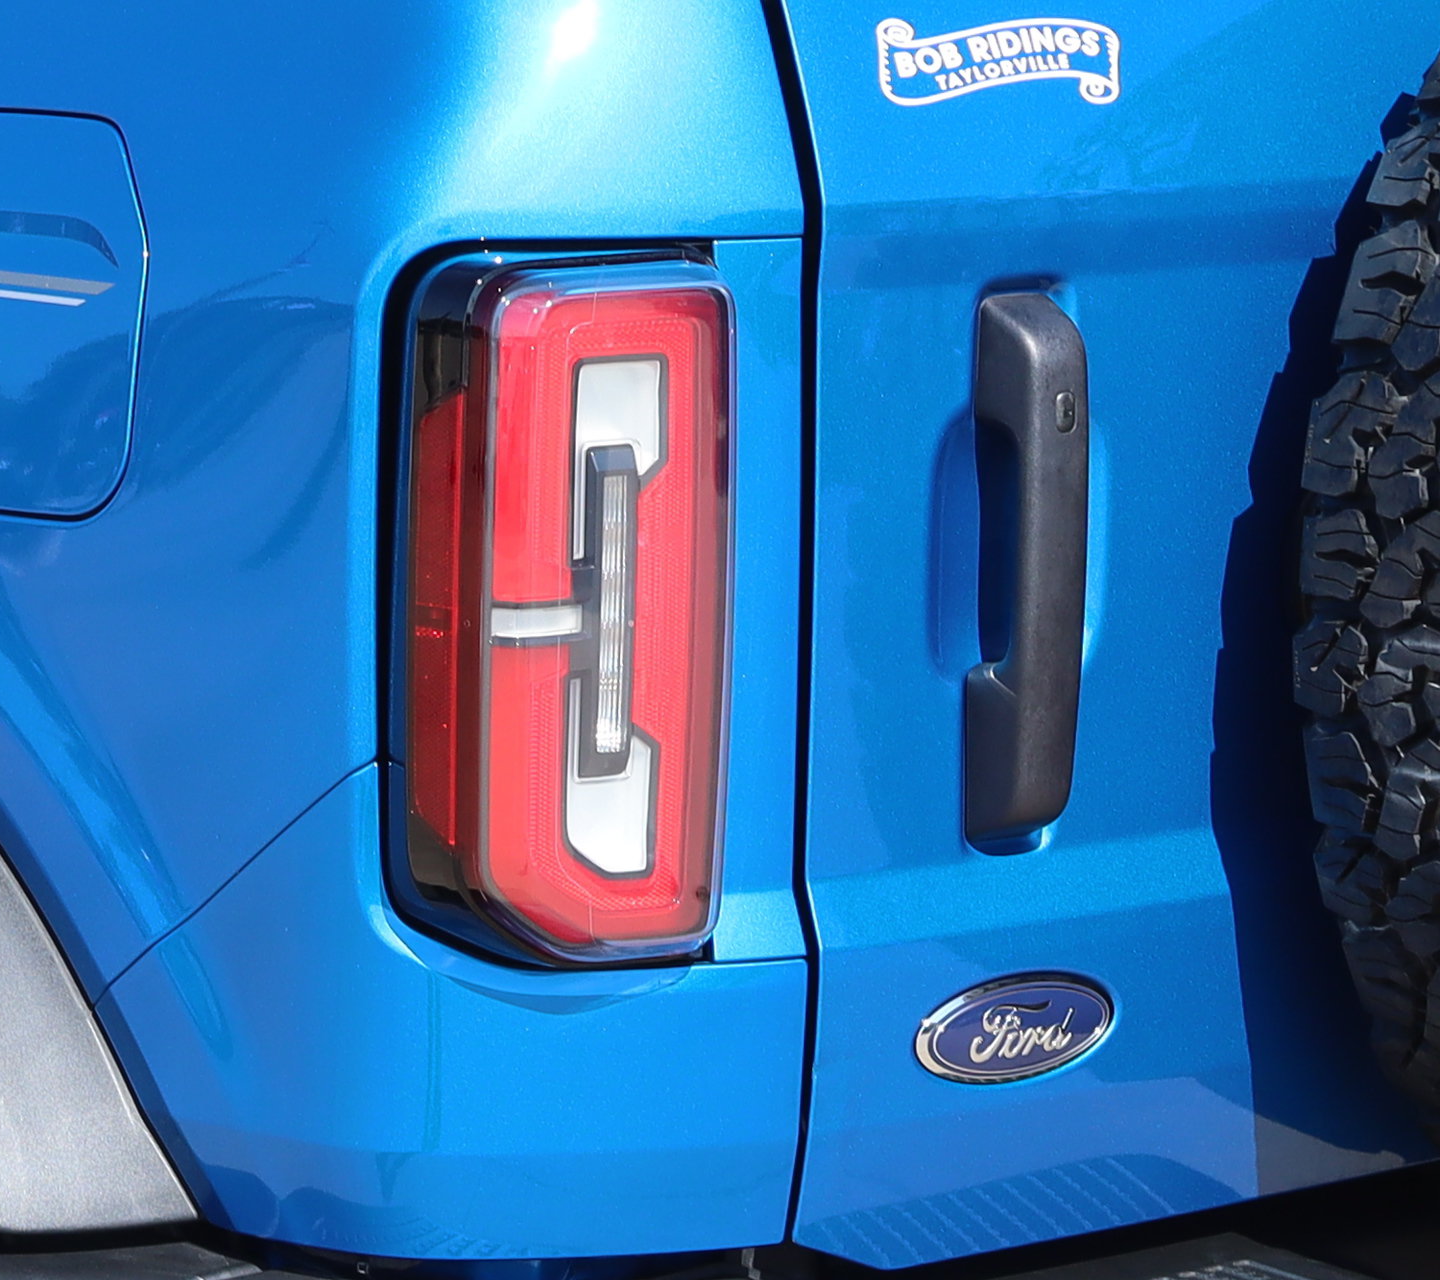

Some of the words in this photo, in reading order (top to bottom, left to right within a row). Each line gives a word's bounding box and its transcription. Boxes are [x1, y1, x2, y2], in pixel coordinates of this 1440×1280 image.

[893, 42, 964, 78] BOB
[966, 26, 1101, 63] RIDINGS
[934, 53, 1070, 91] TAYLORVILLE
[969, 1000, 1074, 1064] Ford
